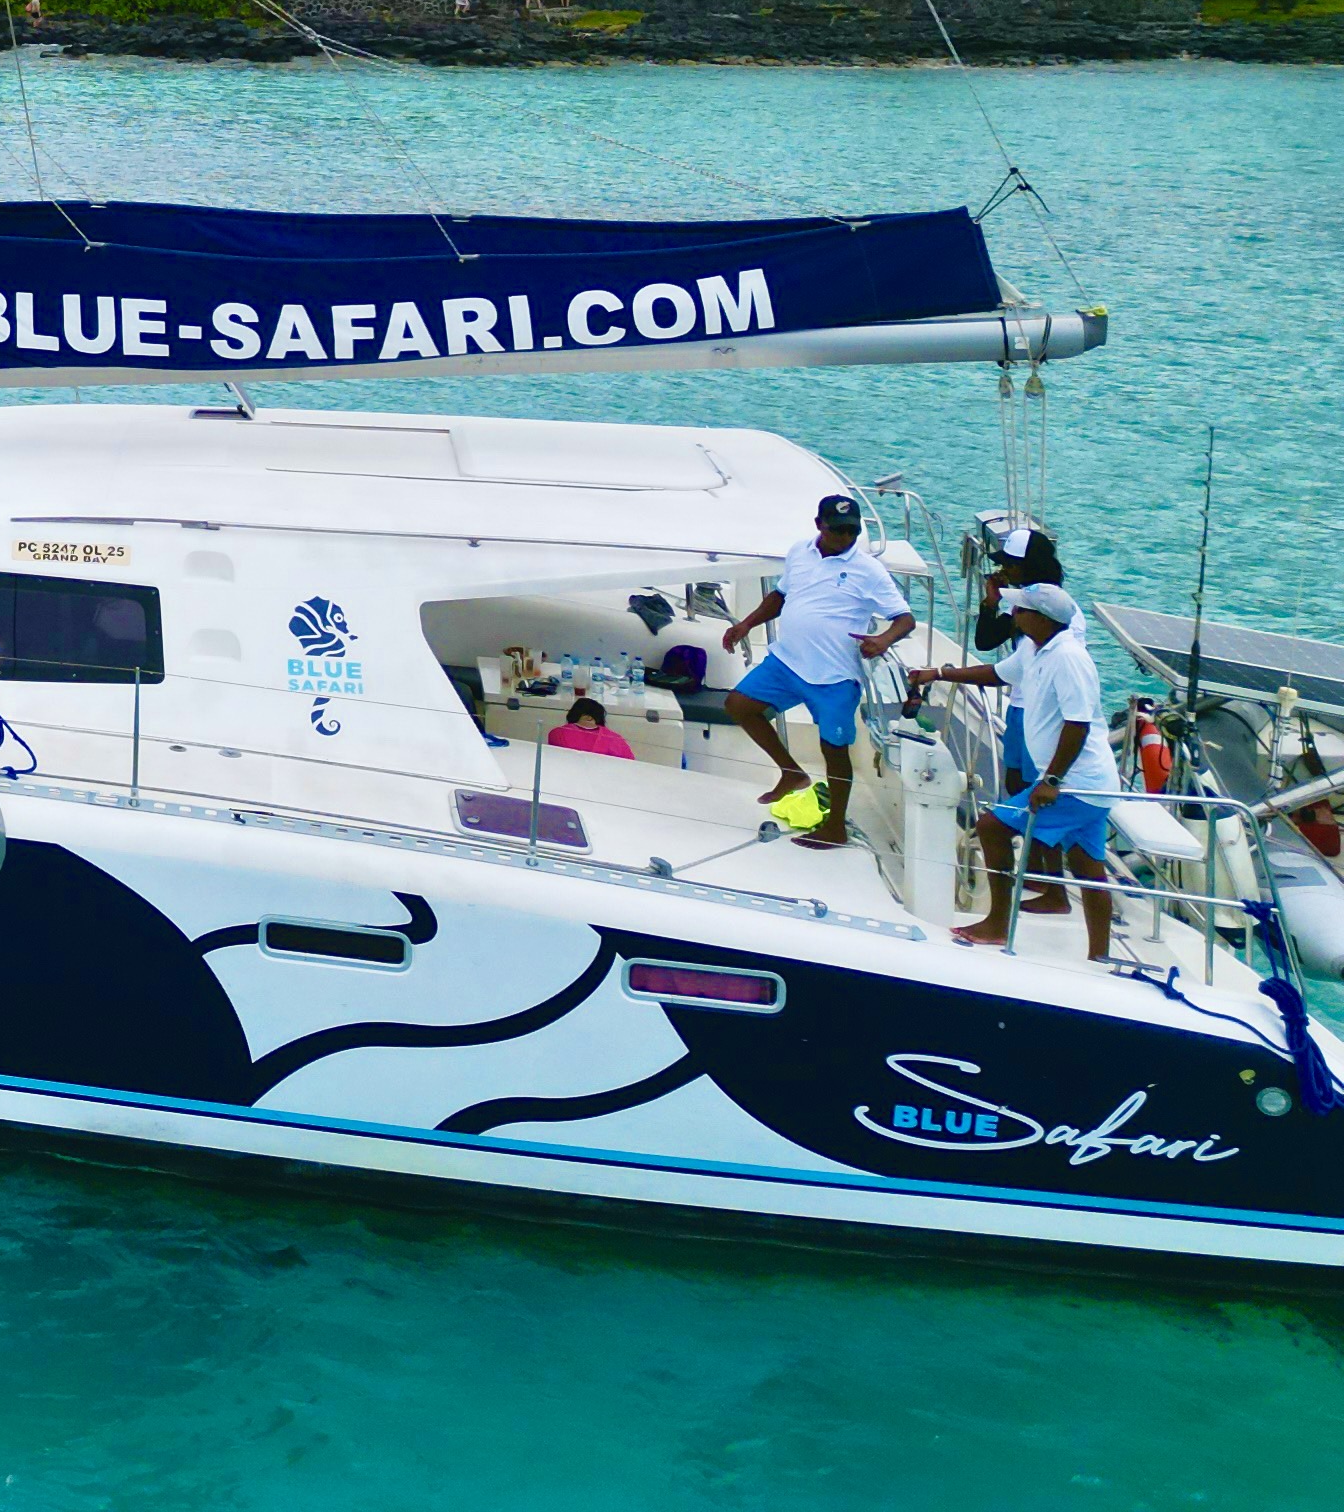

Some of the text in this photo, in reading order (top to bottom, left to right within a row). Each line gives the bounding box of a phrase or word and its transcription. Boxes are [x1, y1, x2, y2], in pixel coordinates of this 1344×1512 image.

[18, 541, 125, 557] PC 5247 OL 25
[32, 552, 109, 564] GRAND BAY
[287, 658, 363, 679] BLUE
[288, 678, 364, 695] SAFARI
[853, 1053, 1241, 1166] BLUE Safari
